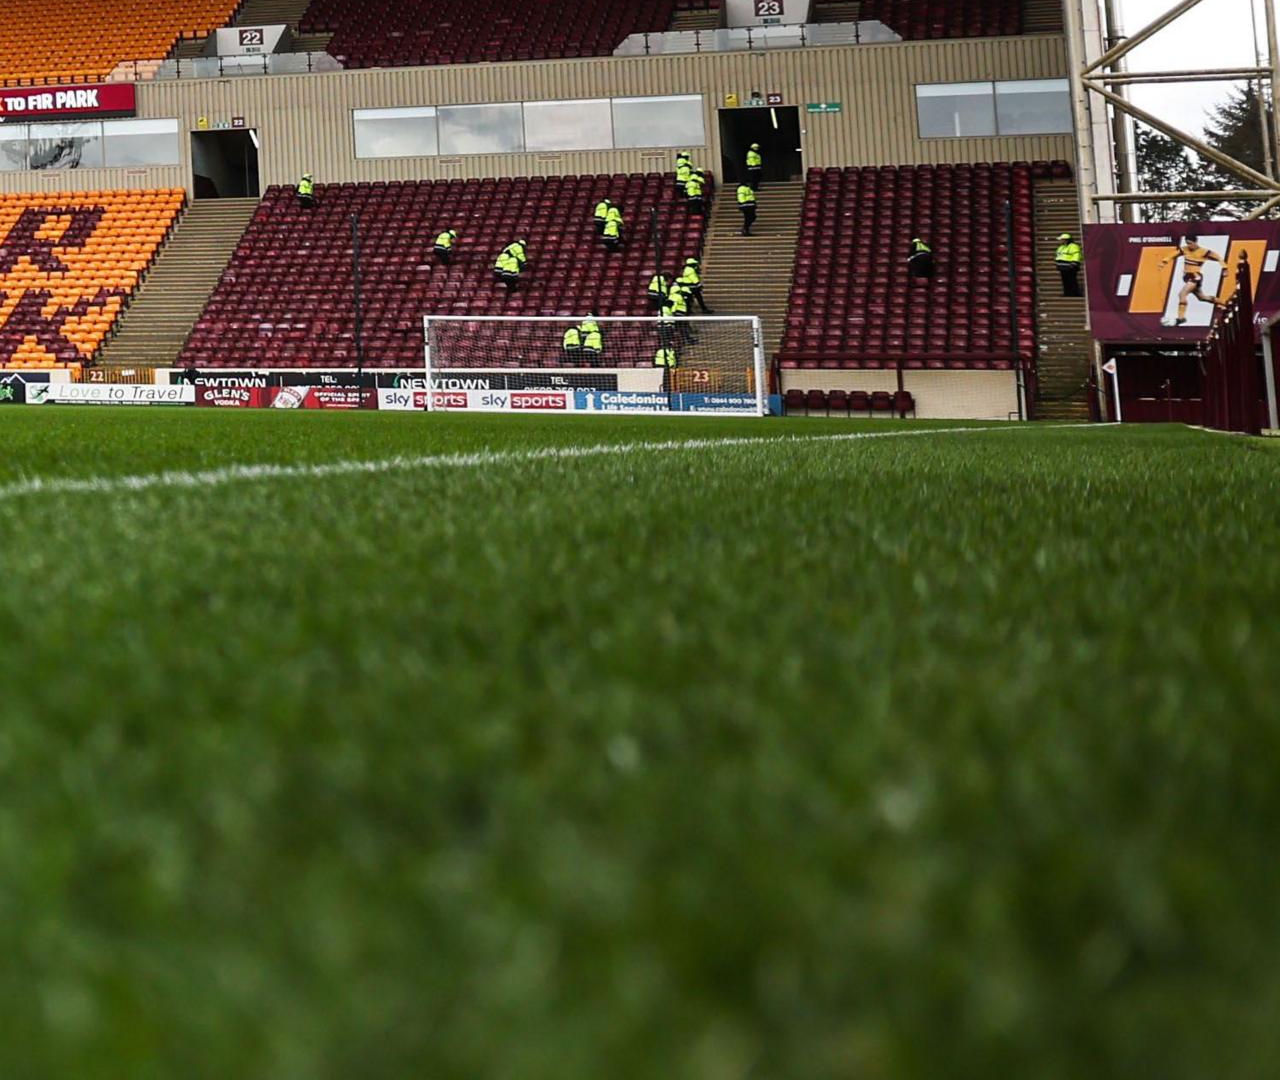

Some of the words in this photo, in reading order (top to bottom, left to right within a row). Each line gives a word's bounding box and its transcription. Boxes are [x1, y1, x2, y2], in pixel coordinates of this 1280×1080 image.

[758, 1, 780, 15] 23
[242, 31, 260, 44] 22
[5, 97, 25, 111] TO
[28, 93, 53, 110] FIR
[55, 90, 98, 108] PARK
[90, 371, 104, 381] 22
[693, 370, 709, 382] 23
[59, 385, 101, 398] Love
[108, 386, 124, 398] to
[132, 386, 185, 400] Travel
[203, 388, 250, 400] GLEN'S
[385, 391, 410, 407] sky
[482, 393, 507, 408] sky
[513, 395, 564, 408] sports
